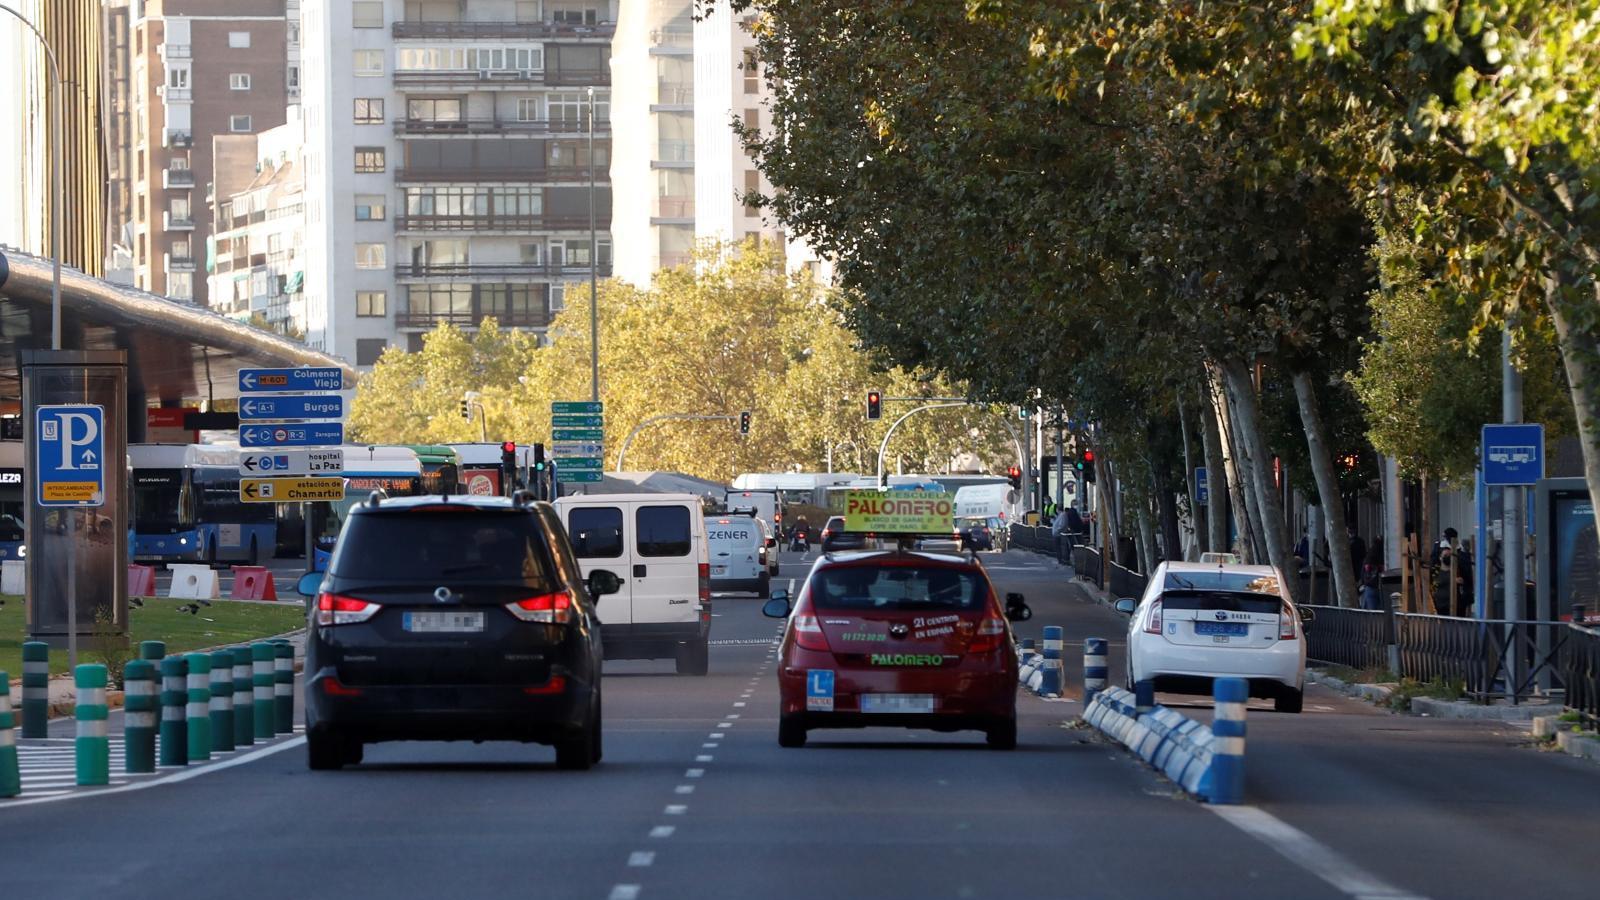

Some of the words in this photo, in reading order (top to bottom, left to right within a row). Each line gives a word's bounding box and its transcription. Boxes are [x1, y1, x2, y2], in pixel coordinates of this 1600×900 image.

[294, 370, 339, 378] Colmenar
[314, 379, 340, 389] Viejo
[304, 403, 340, 412] Burgos
[54, 413, 98, 470] P
[309, 453, 340, 462] hospital
[309, 462, 321, 470] La
[323, 462, 341, 470] Paz
[297, 480, 331, 488] estación
[332, 480, 341, 488] de
[848, 499, 952, 516] PALOMERO
[709, 531, 748, 539] ZENER
[913, 617, 925, 628] 21
[926, 614, 960, 625] CENTROS
[915, 630, 927, 639] EN
[928, 626, 954, 637] ESPAÑA
[871, 654, 943, 666] PALOMERO
[814, 674, 827, 693] L
